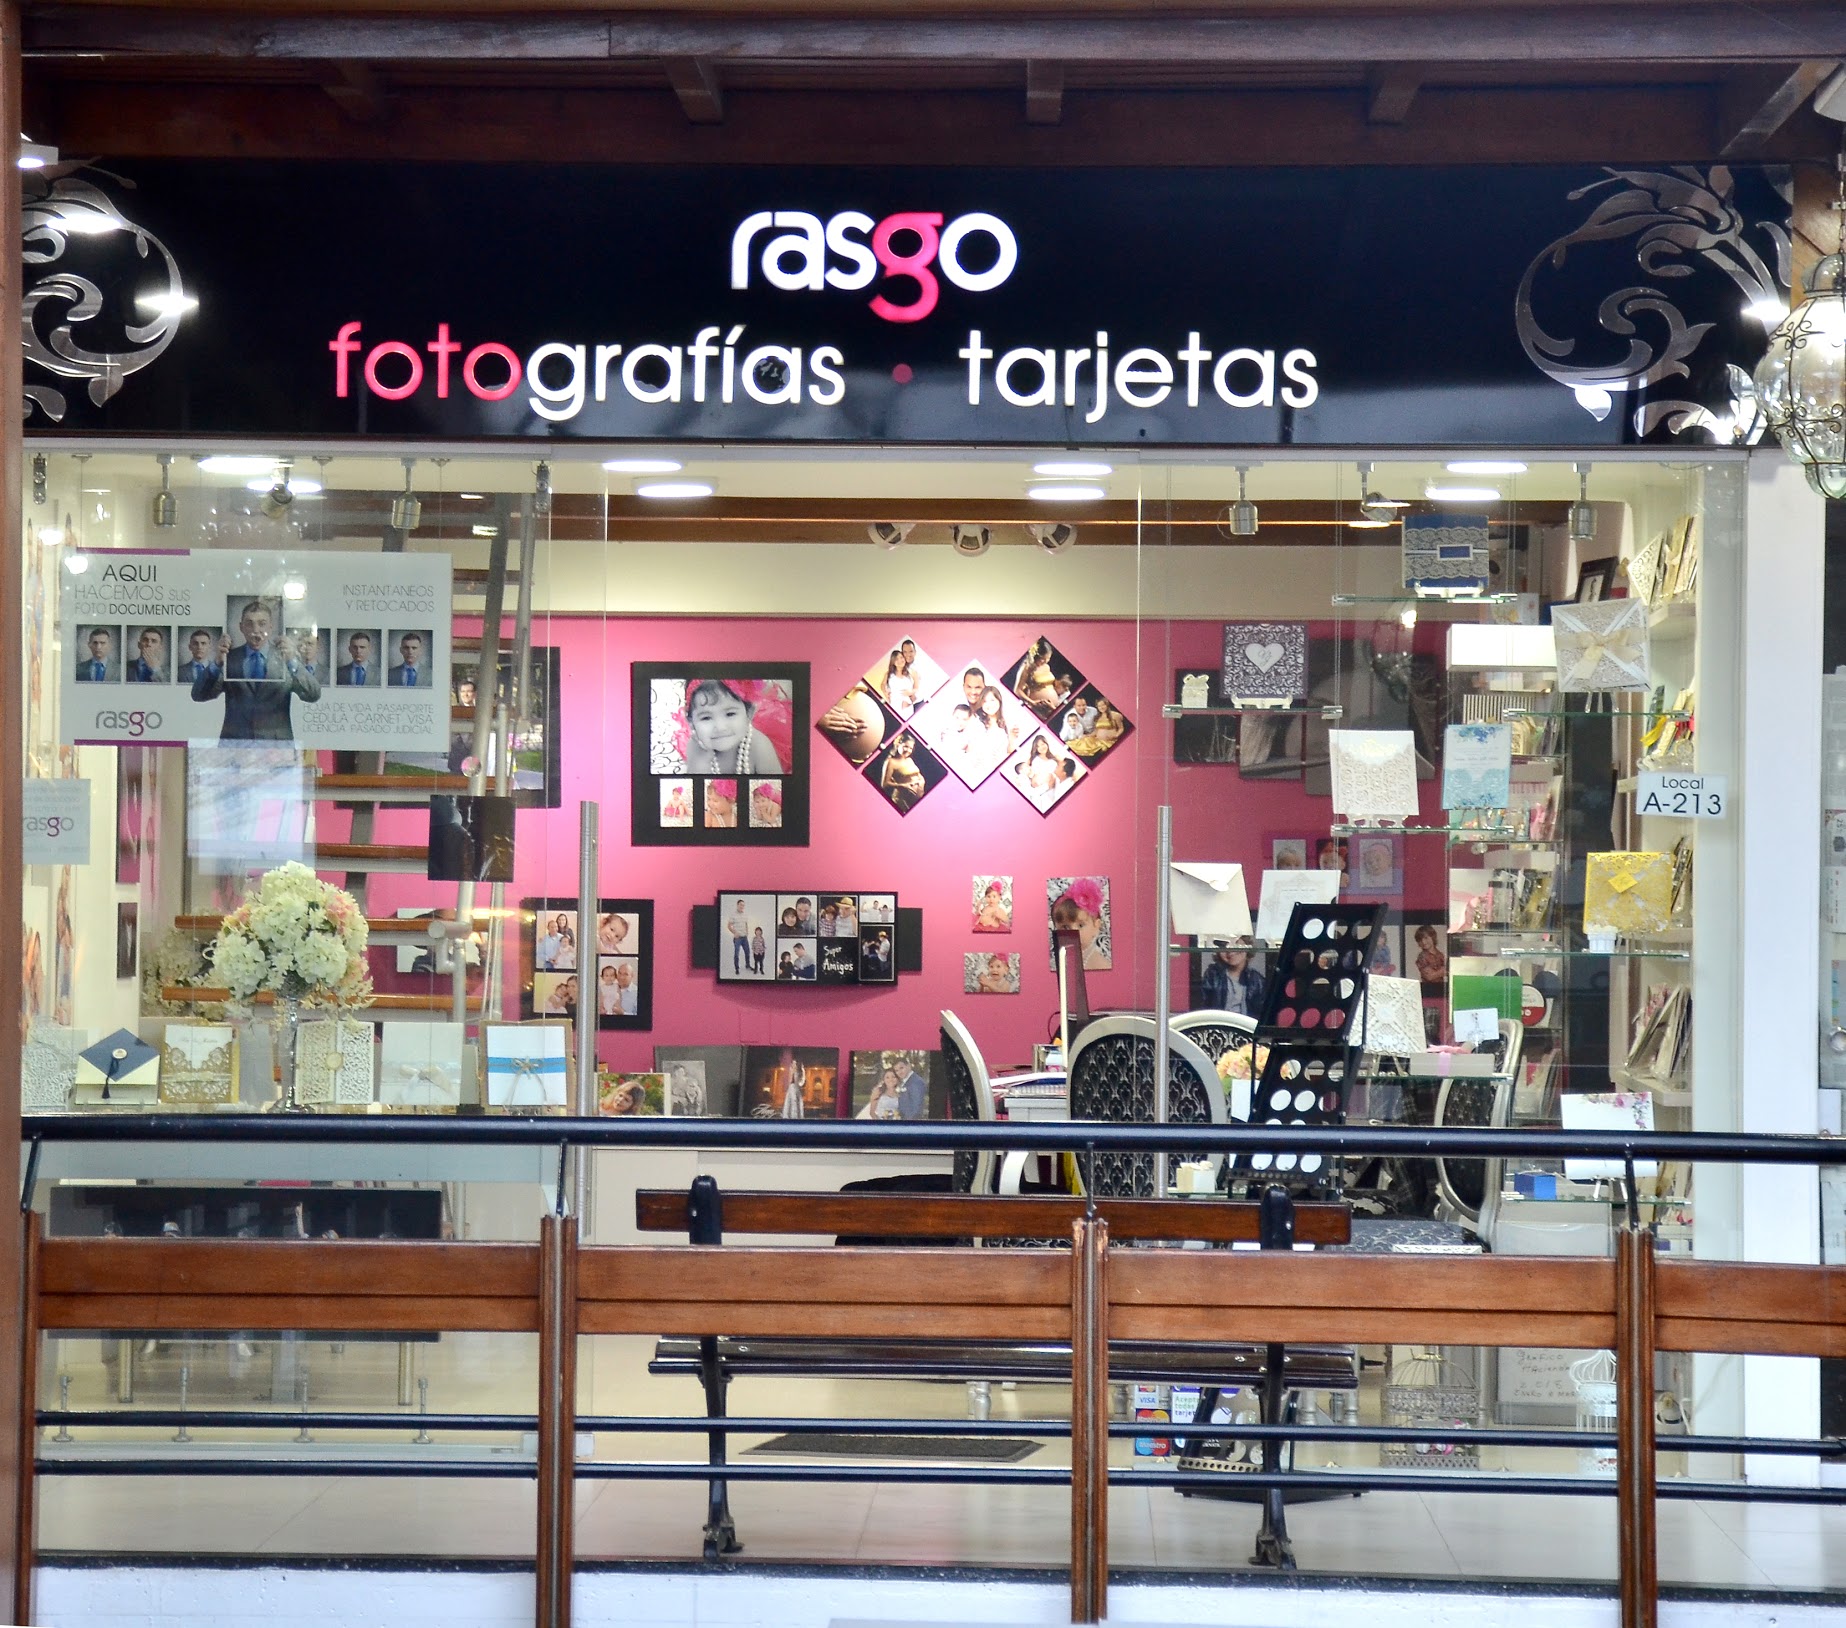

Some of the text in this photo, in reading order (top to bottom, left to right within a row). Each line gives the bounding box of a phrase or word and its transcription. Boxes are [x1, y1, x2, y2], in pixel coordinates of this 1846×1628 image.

[731, 211, 1018, 323] rasgo
[329, 321, 1319, 423] fotografías tarjetas
[102, 564, 157, 582] AQUI
[74, 584, 191, 602] HACEMOS SUS
[342, 584, 435, 598] INSTANTANEOS
[74, 602, 191, 616] FOTO DOCUMENTOS
[345, 600, 435, 613] Y RETOCADOS
[333, 702, 345, 713] DE
[347, 703, 372, 713] VIDA
[377, 703, 434, 714] PASAPORTE
[95, 711, 163, 737] rasgo
[302, 712, 434, 725] CEDULA CARNET VISA
[302, 724, 434, 735] LICENCIA PASADO JUDICIAL
[1662, 776, 1704, 790] Local
[1642, 792, 1722, 815] A-213
[822, 958, 854, 975] Amigos
